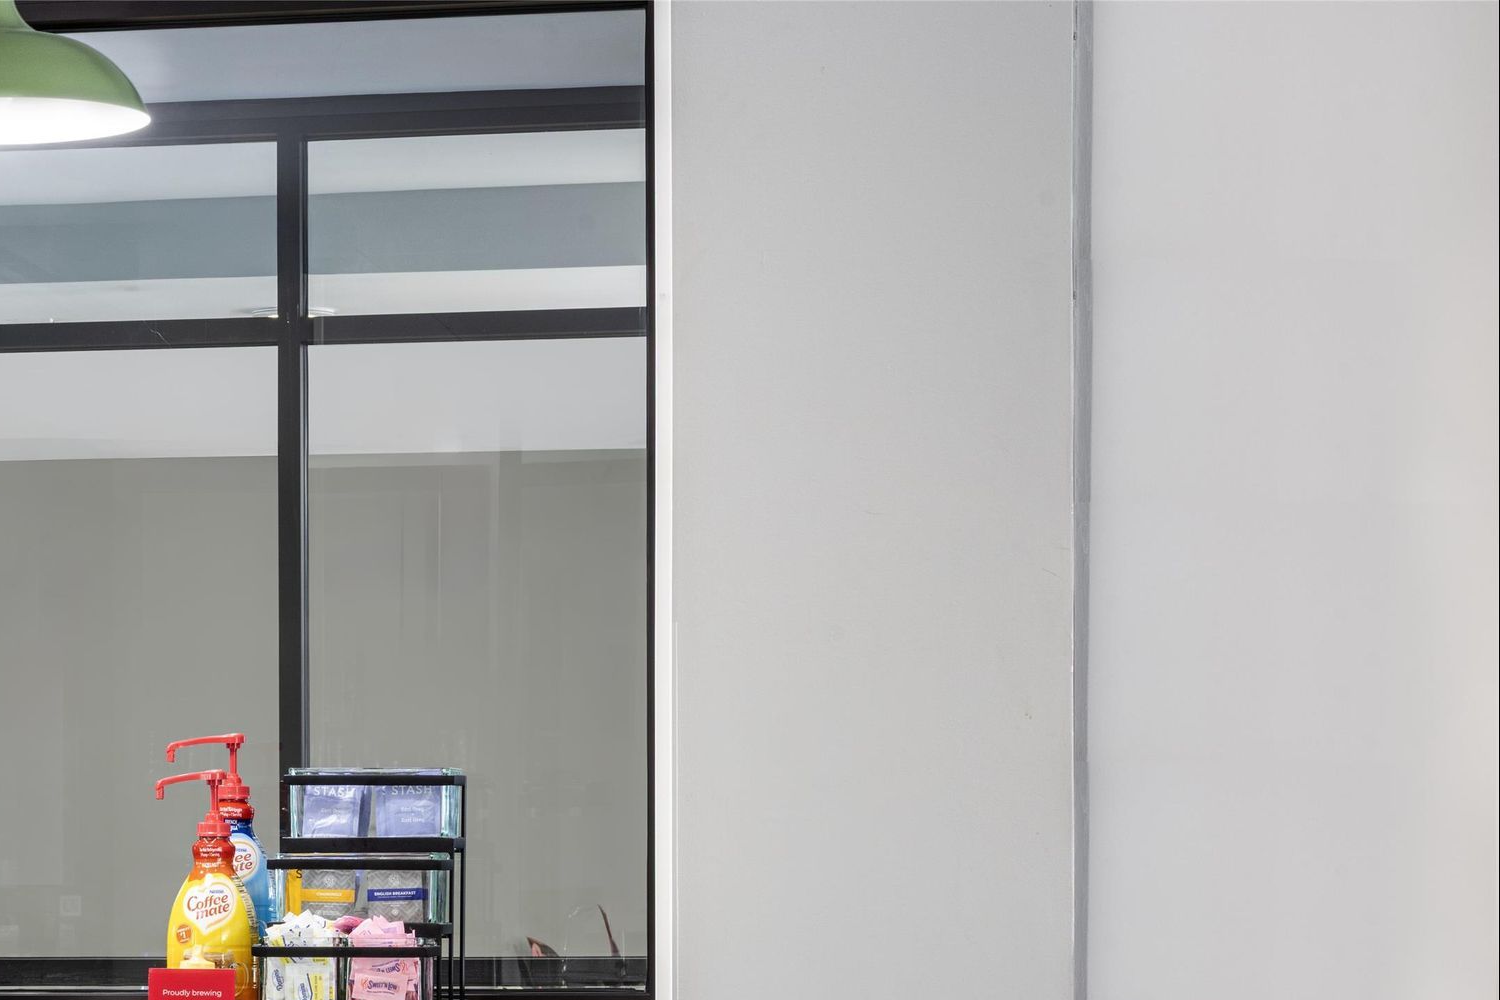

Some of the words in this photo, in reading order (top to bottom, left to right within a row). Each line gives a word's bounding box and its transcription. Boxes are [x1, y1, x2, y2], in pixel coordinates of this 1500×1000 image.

[391, 785, 433, 796] STASH
[186, 894, 229, 912] Coffee
[196, 903, 230, 920] mate
[162, 988, 191, 998] Proudly
[191, 988, 222, 998] brewing
